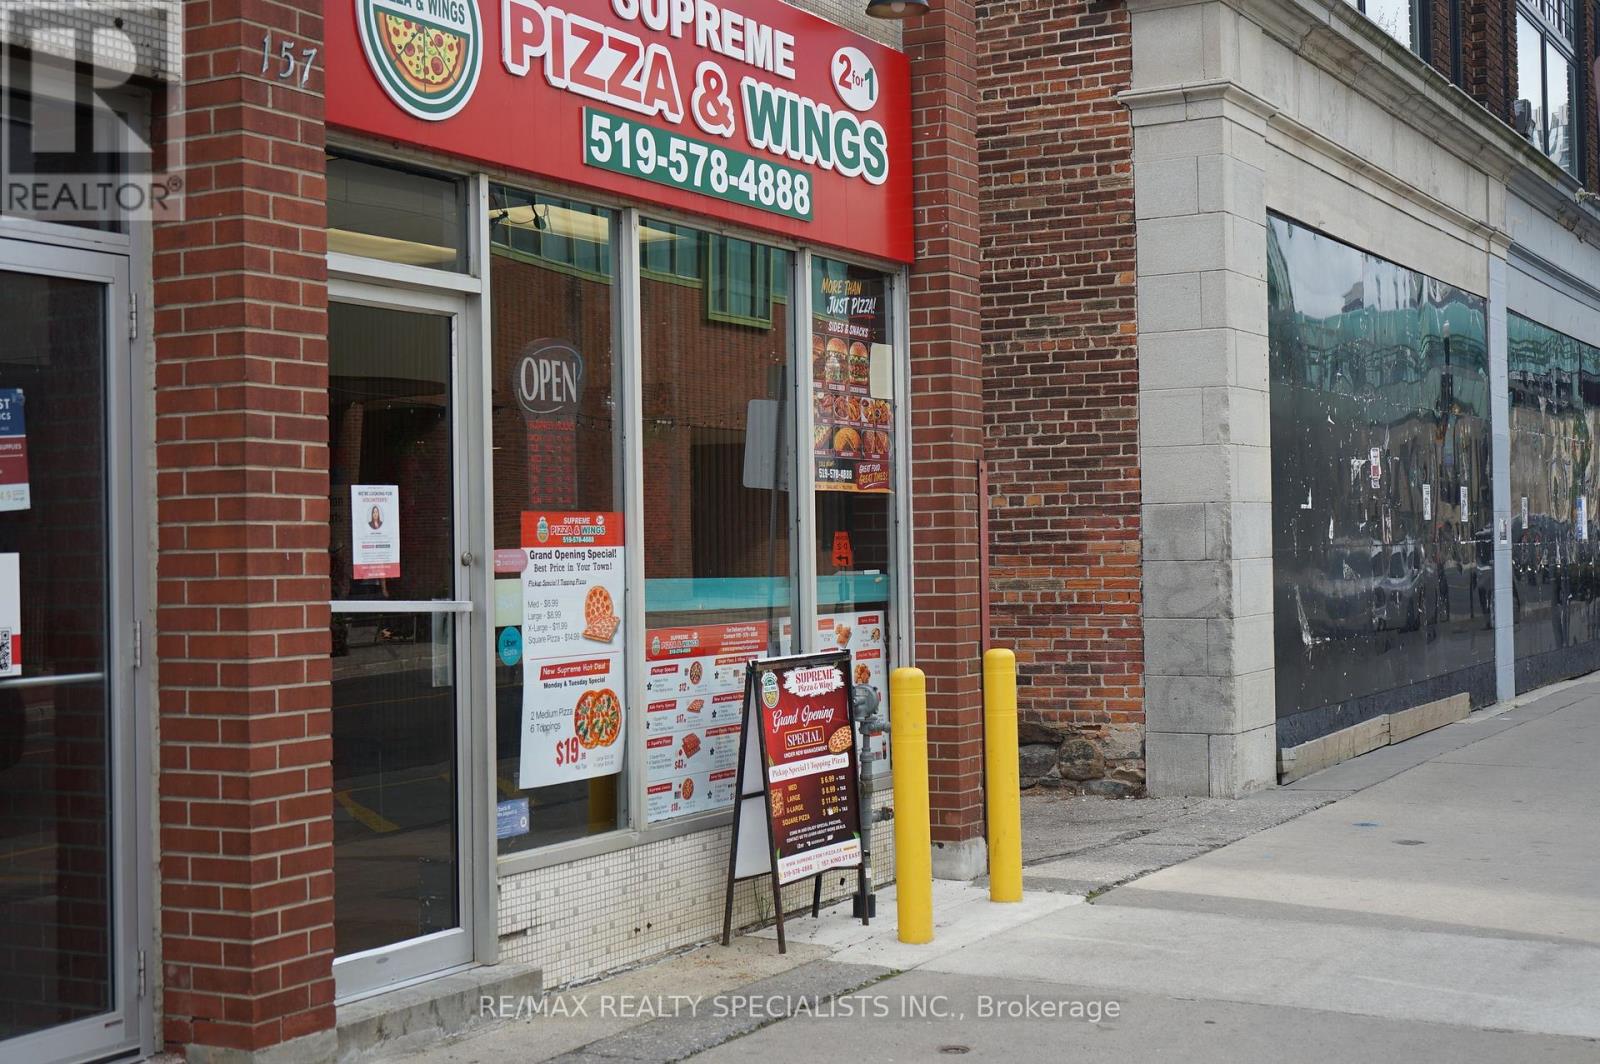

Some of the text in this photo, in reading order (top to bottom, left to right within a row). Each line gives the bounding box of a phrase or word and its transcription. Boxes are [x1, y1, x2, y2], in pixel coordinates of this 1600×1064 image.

[262, 35, 318, 88] 157
[838, 54, 874, 101] 2 for 1
[502, 0, 889, 185] PIZZA & WINGS
[590, 115, 811, 215] 519-578-4888
[821, 277, 862, 296] MORE THAN
[827, 295, 877, 316] JUST PIZZA!
[520, 357, 577, 403] OPEN
[551, 525, 573, 535] PIZZA
[581, 525, 606, 535] WINGS
[530, 549, 617, 560] Grand Opening Special!
[534, 563, 547, 572] Best
[549, 563, 565, 572] Price
[577, 562, 590, 571] Your
[593, 562, 612, 571] Town!
[544, 681, 562, 689] Monday
[569, 678, 588, 687] Tuesday
[795, 669, 834, 683] SUPREME
[772, 704, 835, 733] Grand Opening
[787, 730, 822, 747] SPECIAL
[556, 736, 579, 768] $19
